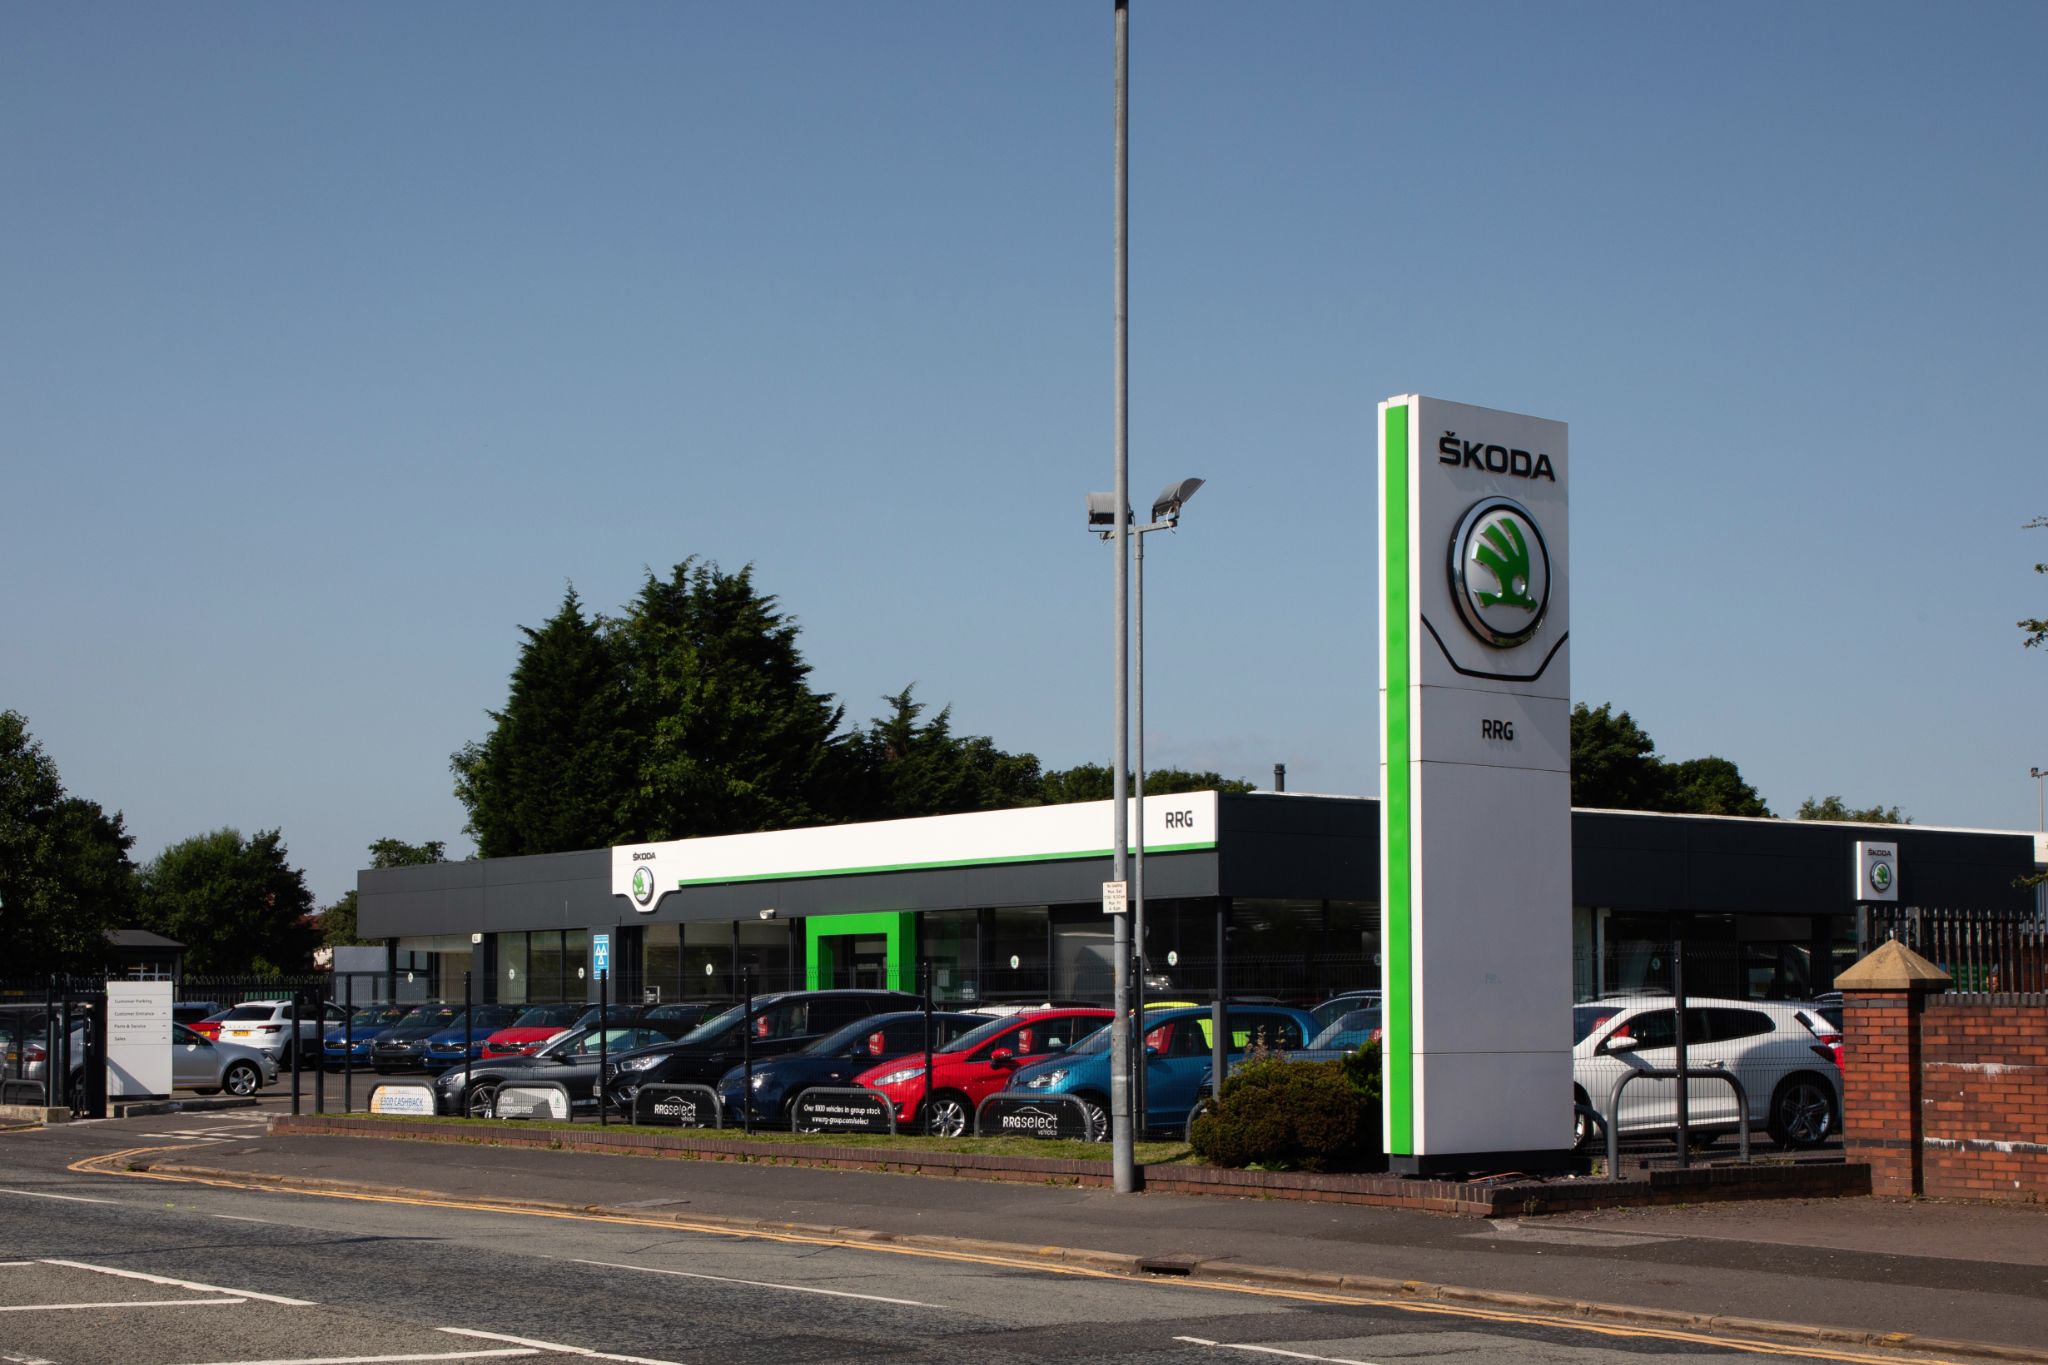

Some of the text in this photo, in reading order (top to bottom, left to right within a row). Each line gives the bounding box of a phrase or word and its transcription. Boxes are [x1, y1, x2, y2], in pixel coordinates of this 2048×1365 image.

[1438, 430, 1556, 482] ŠKODA
[1481, 719, 1514, 741] RRG
[1165, 810, 1193, 829] RRG
[632, 852, 656, 861] ŠKODA
[1867, 848, 1892, 857] ŠKODA
[803, 1104, 814, 1112] Over
[850, 1107, 866, 1115] group
[866, 1107, 881, 1115] stock
[1002, 1113, 1058, 1129] RRGselect
